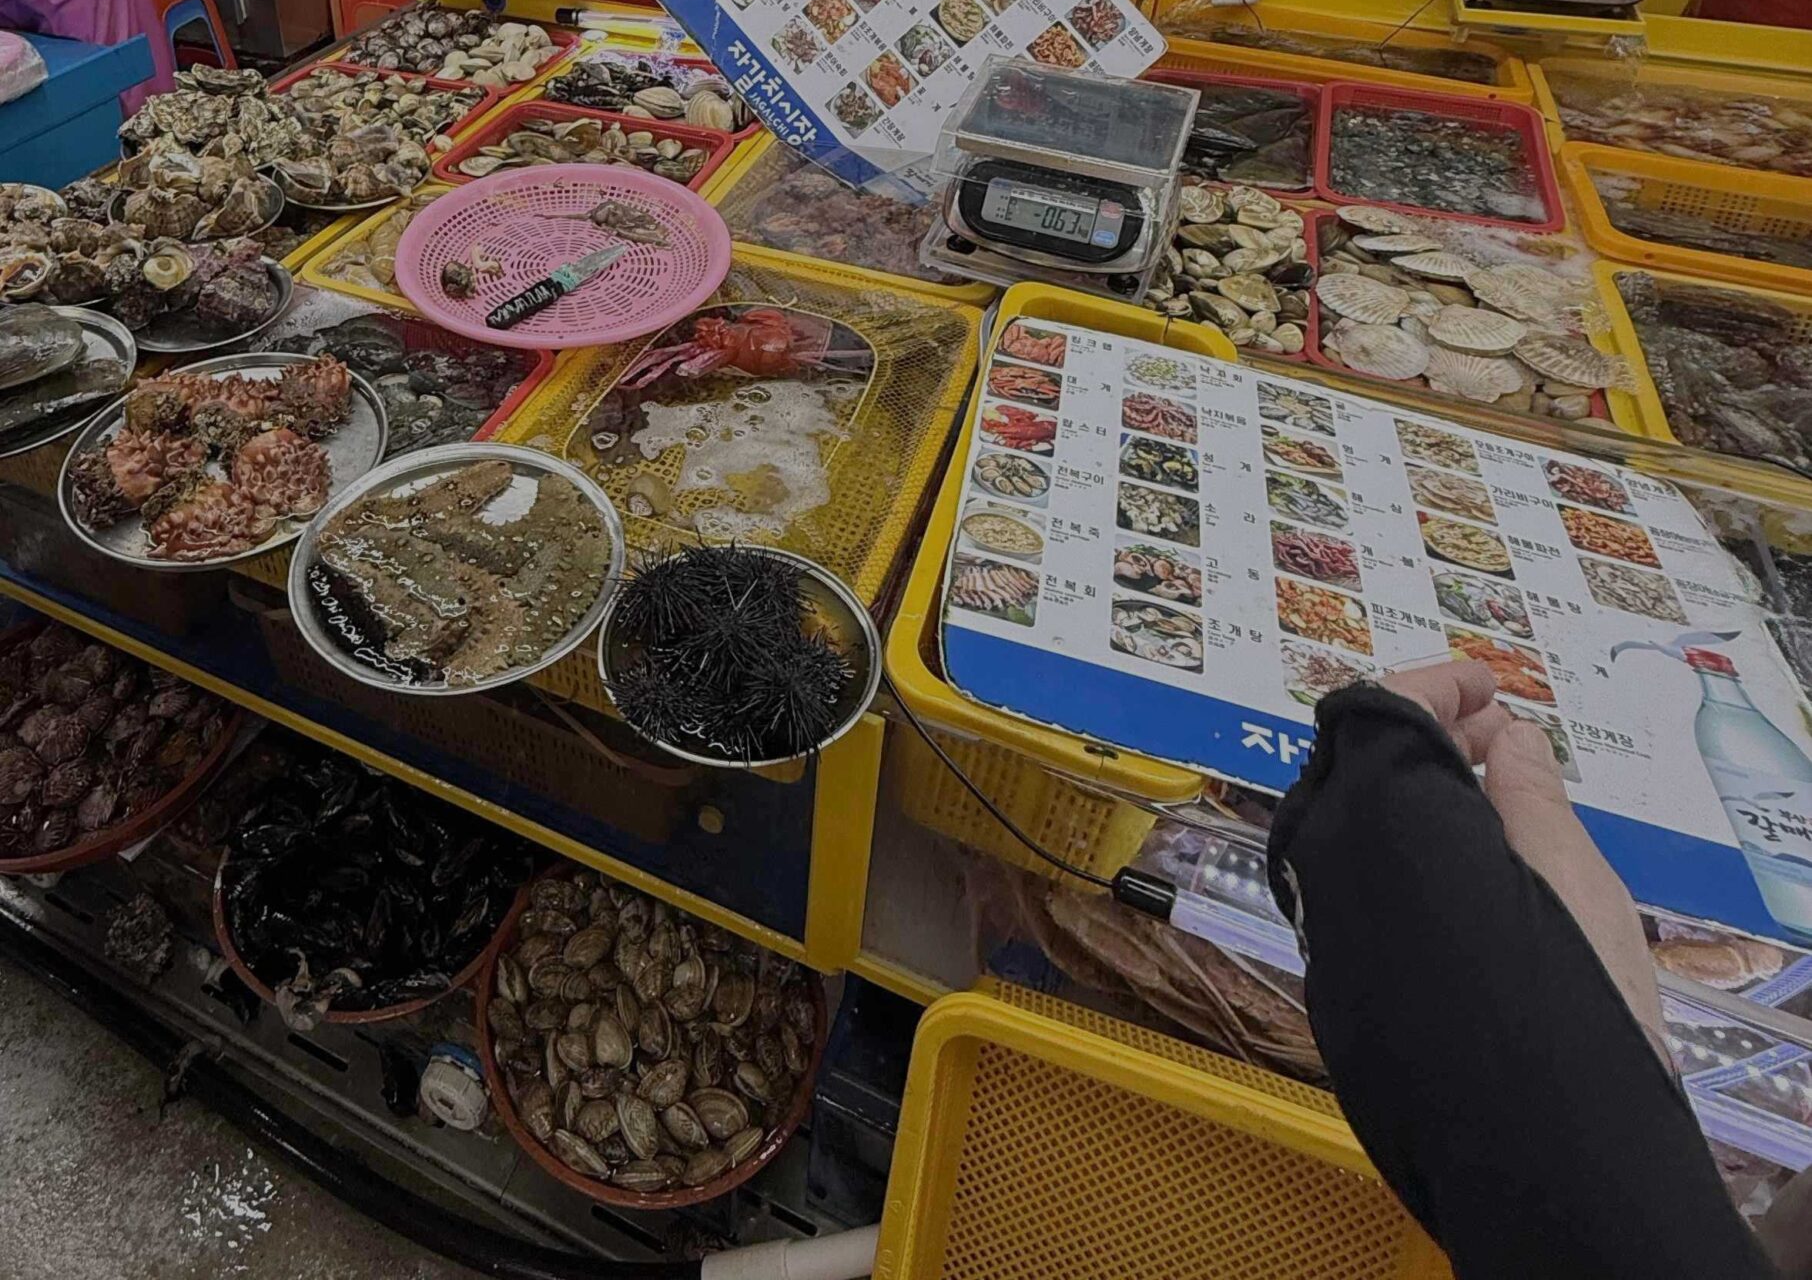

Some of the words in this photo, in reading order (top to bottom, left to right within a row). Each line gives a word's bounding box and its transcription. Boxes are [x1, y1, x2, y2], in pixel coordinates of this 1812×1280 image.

[727, 39, 818, 147] 자갈치시장
[750, 92, 790, 136] JAGALCHI
[1062, 419, 1107, 436] 랍스터
[1057, 466, 1105, 485] 전복구이
[1491, 486, 1555, 511] 가리비구이
[1205, 503, 1256, 524] 소라
[1045, 574, 1096, 598] 전복회
[1208, 618, 1263, 643] 조개탕
[1569, 719, 1635, 748] 간장게장
[1736, 808, 1812, 842] 갈매
